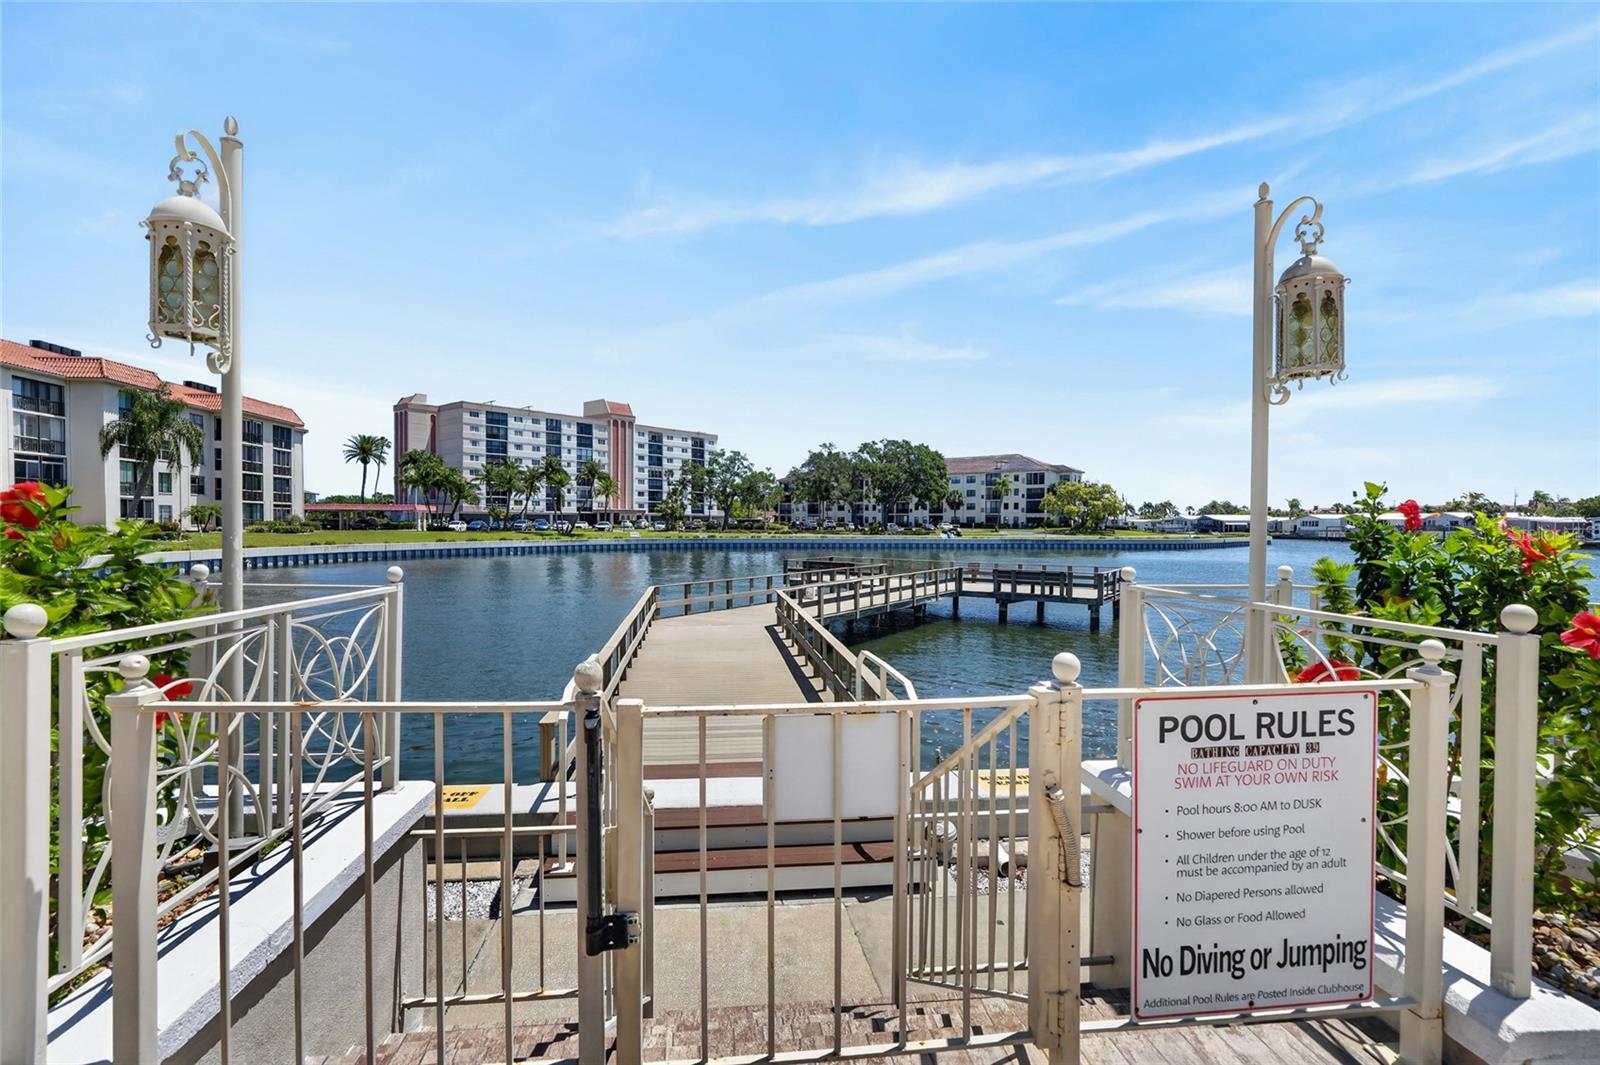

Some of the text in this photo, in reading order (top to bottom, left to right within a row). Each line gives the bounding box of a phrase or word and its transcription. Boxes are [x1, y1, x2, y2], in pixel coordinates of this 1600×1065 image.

[1159, 709, 1355, 743] POOL RULES
[1191, 742, 1320, 758] BATHING CAPACITY 39
[1178, 757, 1337, 775] NO LIFEGUARD ON DUTY
[1174, 770, 1339, 789] SWIM AT YOUR OWN RISK
[1177, 798, 1322, 816] Pool hours 8:00 AM to DUSK
[1177, 824, 1305, 841] Shower before using Pool
[1176, 847, 1330, 865] All Children under the age of 12
[1176, 858, 1347, 878] must be accompanied by an adult
[1177, 883, 1323, 903] No Diapered Persons allowed
[1177, 909, 1306, 927] No Glass or Food Allowed
[1143, 934, 1367, 980] No Diving or Jumping
[1143, 983, 1364, 1009] Additional Pool Rules are Posted Inside Clubhouse
